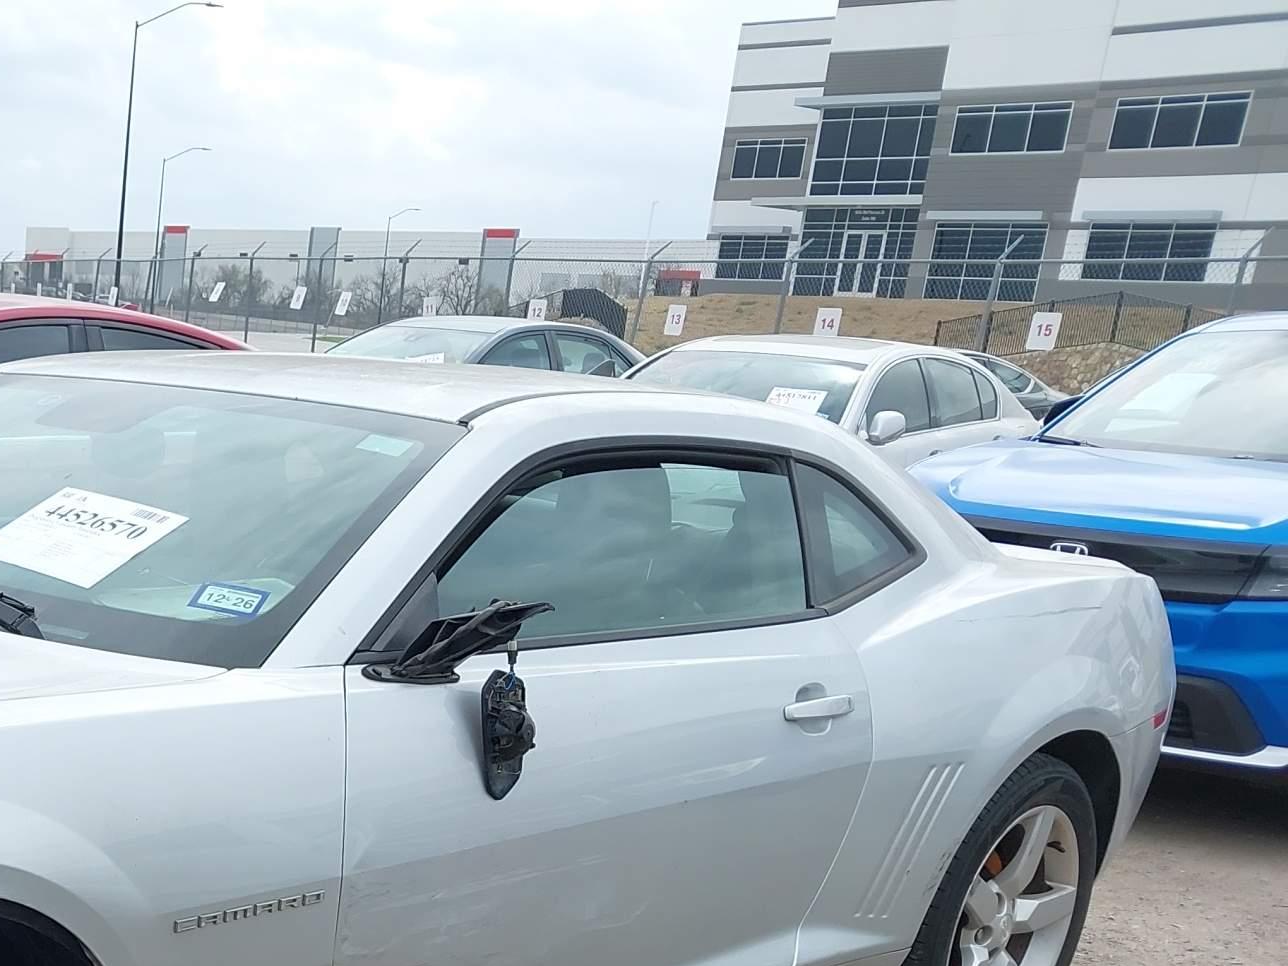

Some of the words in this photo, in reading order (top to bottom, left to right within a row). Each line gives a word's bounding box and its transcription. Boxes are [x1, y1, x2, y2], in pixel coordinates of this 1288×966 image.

[532, 307, 543, 318] 12
[670, 314, 681, 325] 13
[821, 318, 835, 330] 14
[1037, 323, 1053, 337] 15
[44, 504, 148, 540] 44526570
[173, 889, 325, 933] CAMARO
